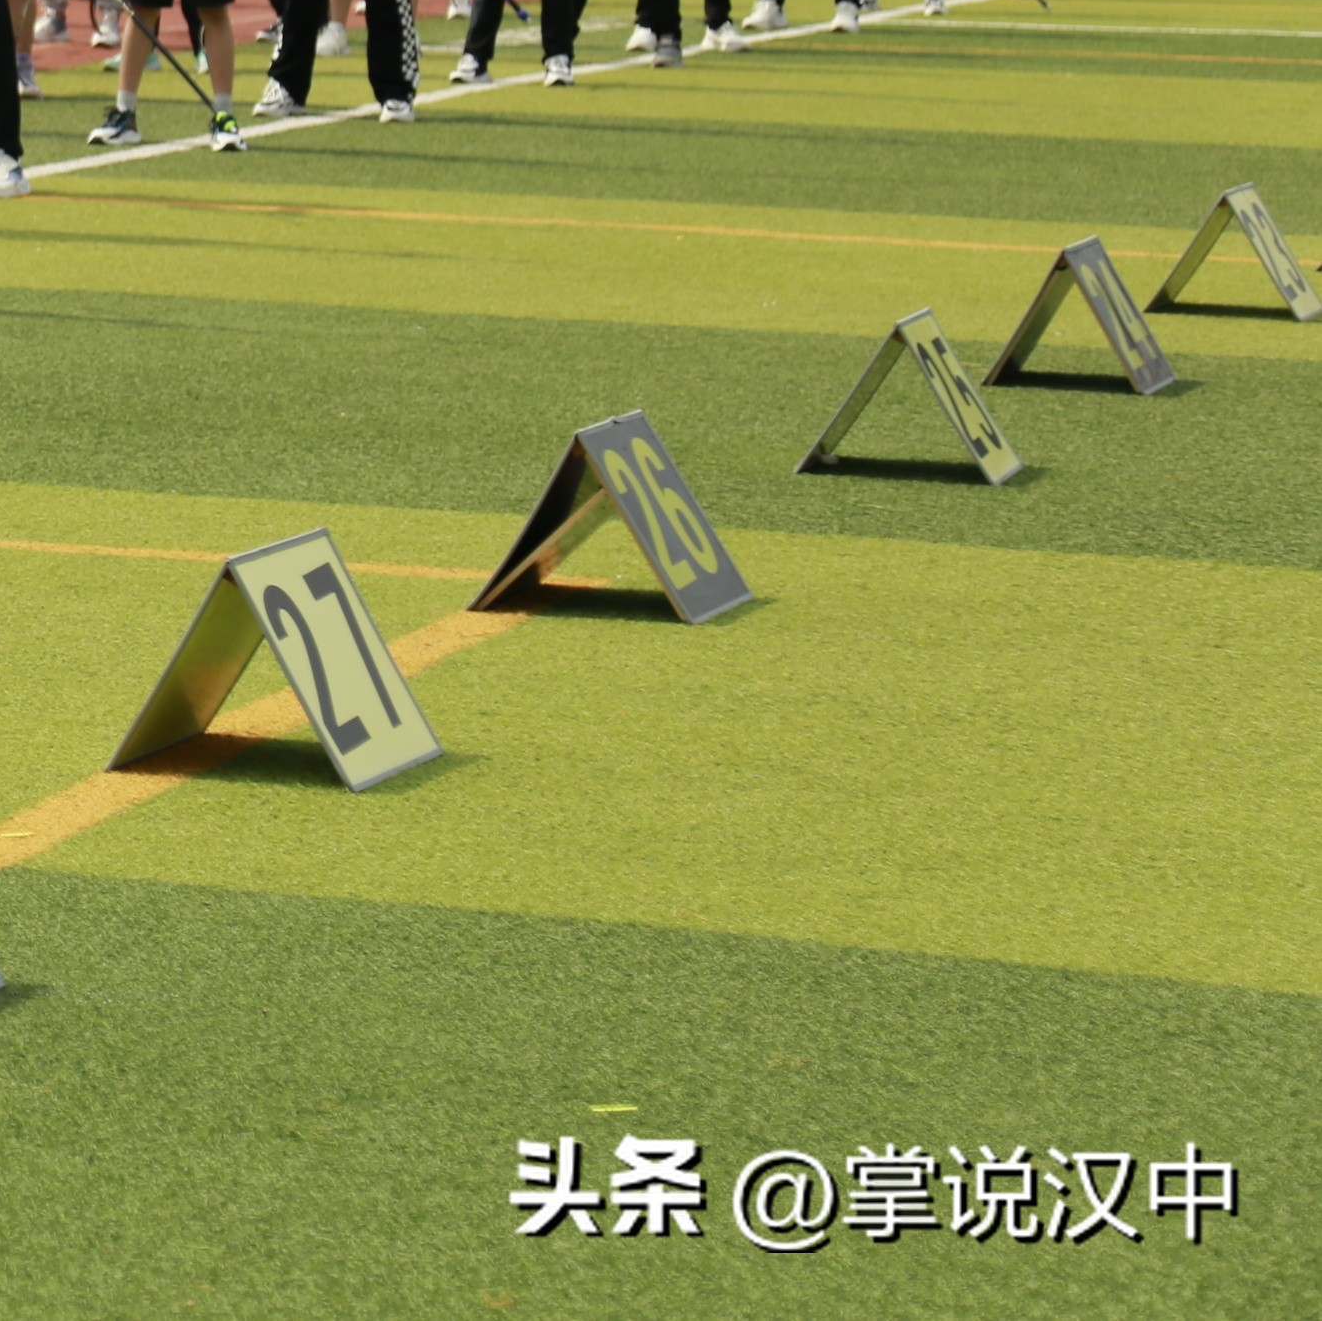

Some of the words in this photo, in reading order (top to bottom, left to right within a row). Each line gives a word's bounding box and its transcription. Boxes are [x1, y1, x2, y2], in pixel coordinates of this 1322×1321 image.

[1240, 202, 1307, 301] 23
[1080, 259, 1158, 370] 24
[916, 336, 1002, 459] 25
[603, 437, 718, 590] 26
[263, 562, 402, 756] 27
